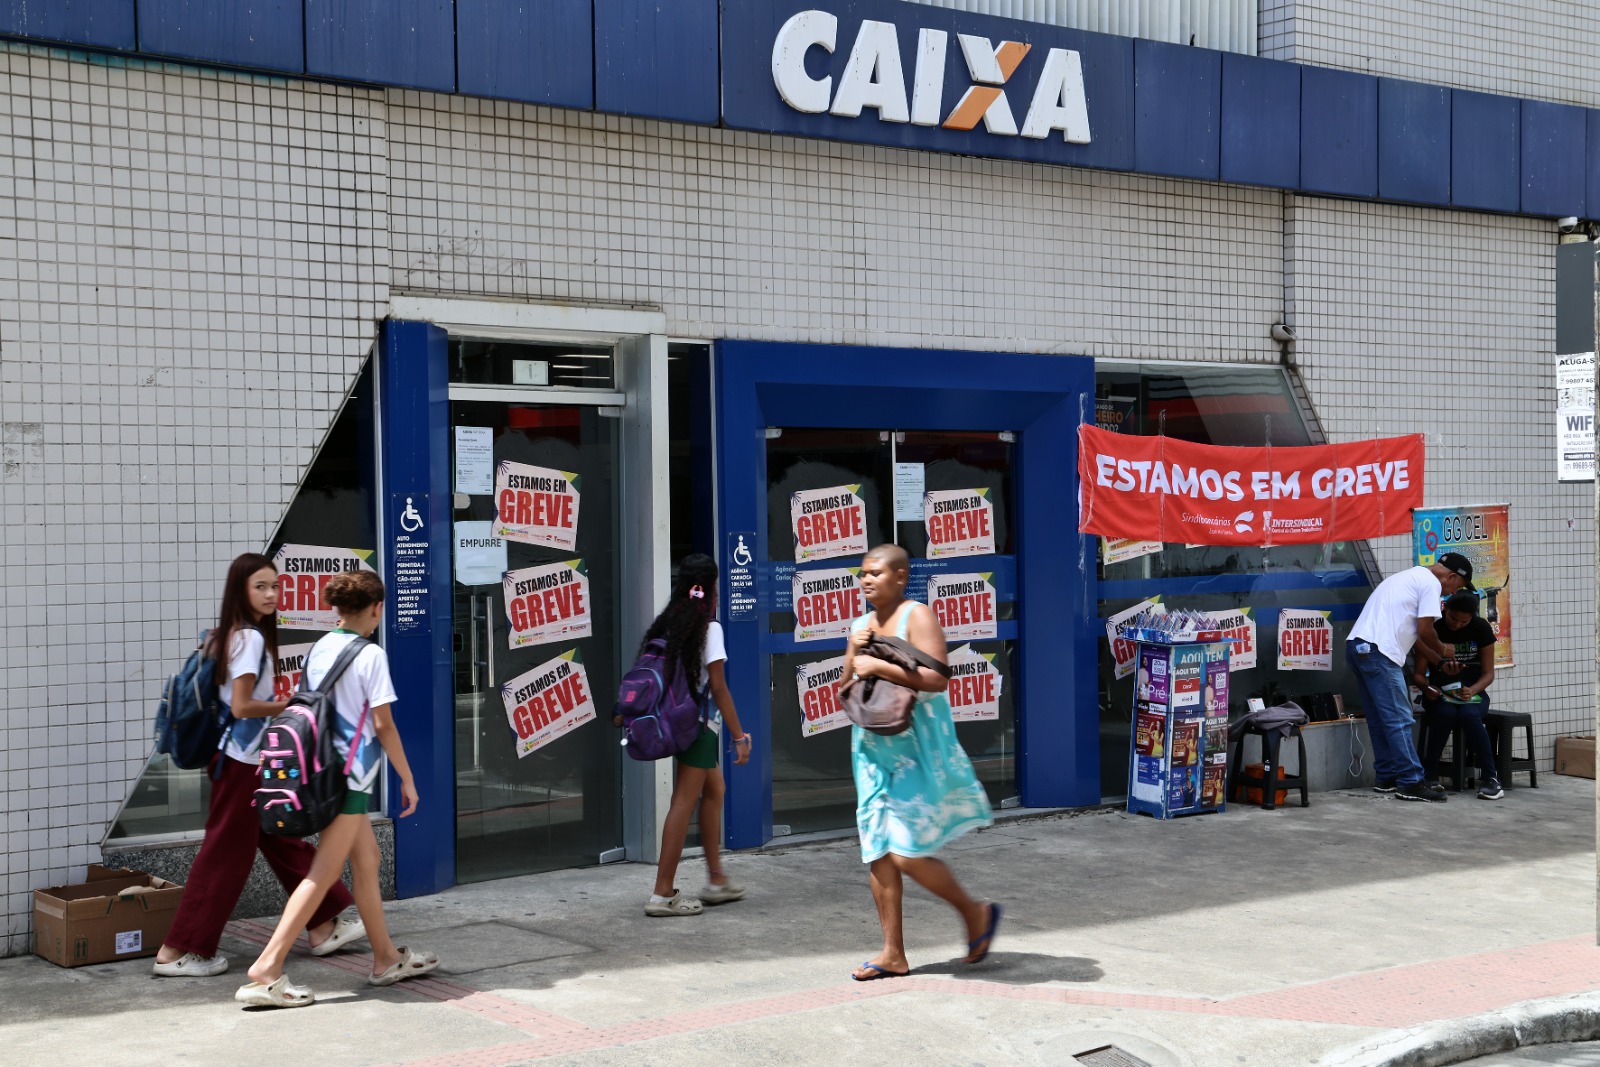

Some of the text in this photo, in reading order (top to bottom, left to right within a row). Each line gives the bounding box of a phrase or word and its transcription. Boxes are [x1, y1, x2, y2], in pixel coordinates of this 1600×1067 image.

[772, 10, 1091, 144] CAIXA
[1560, 358, 1595, 366] ALUGA-S
[1096, 410, 1123, 424] HEIRO
[508, 474, 566, 493] ESTAMOS EM
[1095, 453, 1410, 502] ESTAMOS EM GREVE
[500, 489, 572, 528] GREVE
[802, 494, 853, 514] ESTAMOS EM
[934, 496, 981, 514] ESTAMOS EM
[797, 505, 862, 547] GREVE
[929, 508, 990, 545] GREVE
[1272, 518, 1323, 528] INTERSINDICAL
[1443, 515, 1488, 543] GG CEL
[460, 539, 501, 548] EMPURRE
[285, 558, 359, 572] ESTAMOS EM
[277, 574, 337, 611] GRE
[516, 569, 573, 596] ESTAMOS EM
[802, 575, 853, 594] ESTAMOS EM
[937, 582, 973, 598] ESTAMOS
[974, 580, 985, 592] EM
[510, 582, 585, 632] GREVE
[798, 588, 863, 627] GREVE
[932, 593, 993, 628] GREVE
[1235, 615, 1245, 627] EM
[1286, 617, 1324, 628] ESTAMOS EM
[1282, 628, 1329, 656] GREVE
[977, 661, 987, 673] EM
[1181, 650, 1224, 664] AQUI TEM
[515, 662, 571, 704] ESTAMOS EM
[949, 674, 995, 707] REVE
[513, 672, 588, 739] GREVE
[804, 681, 843, 721] GRE
